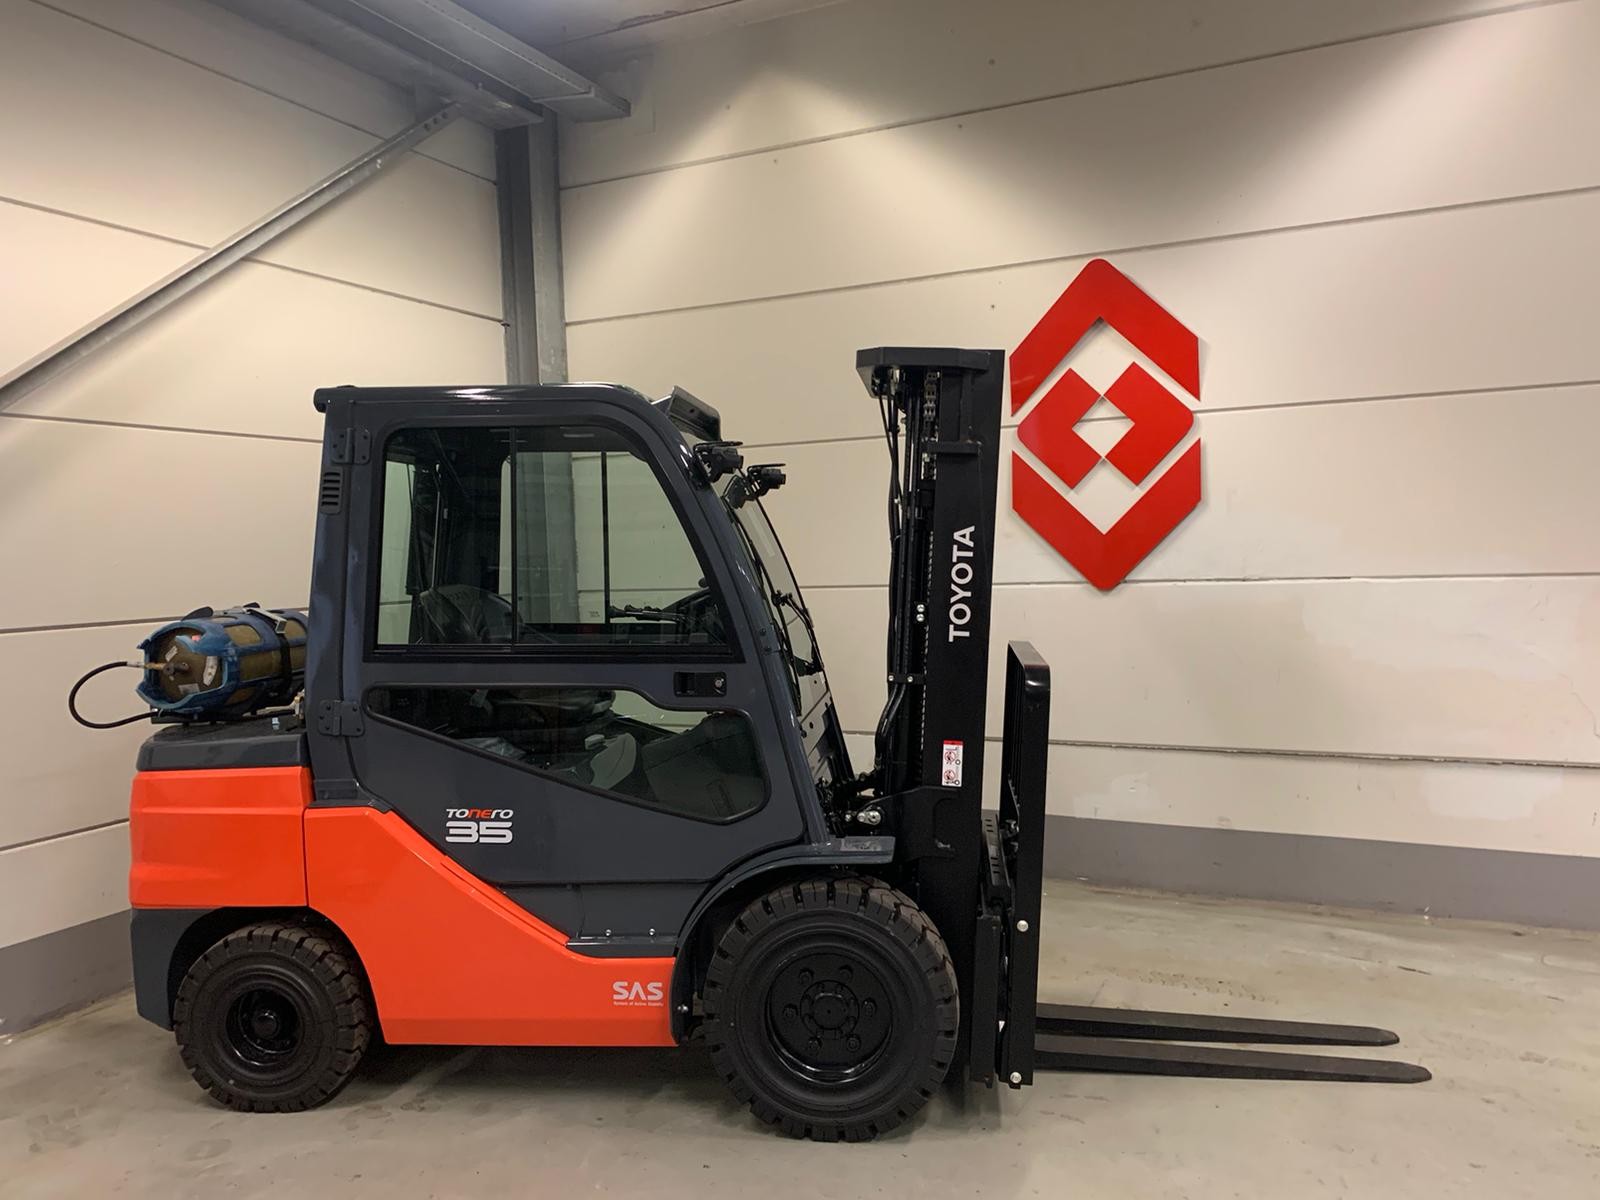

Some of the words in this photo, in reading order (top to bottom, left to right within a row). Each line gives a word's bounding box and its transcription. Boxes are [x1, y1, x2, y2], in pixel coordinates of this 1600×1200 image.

[948, 525, 975, 642] TOYOTA
[445, 821, 513, 843] 35
[612, 981, 664, 1001] SAS
